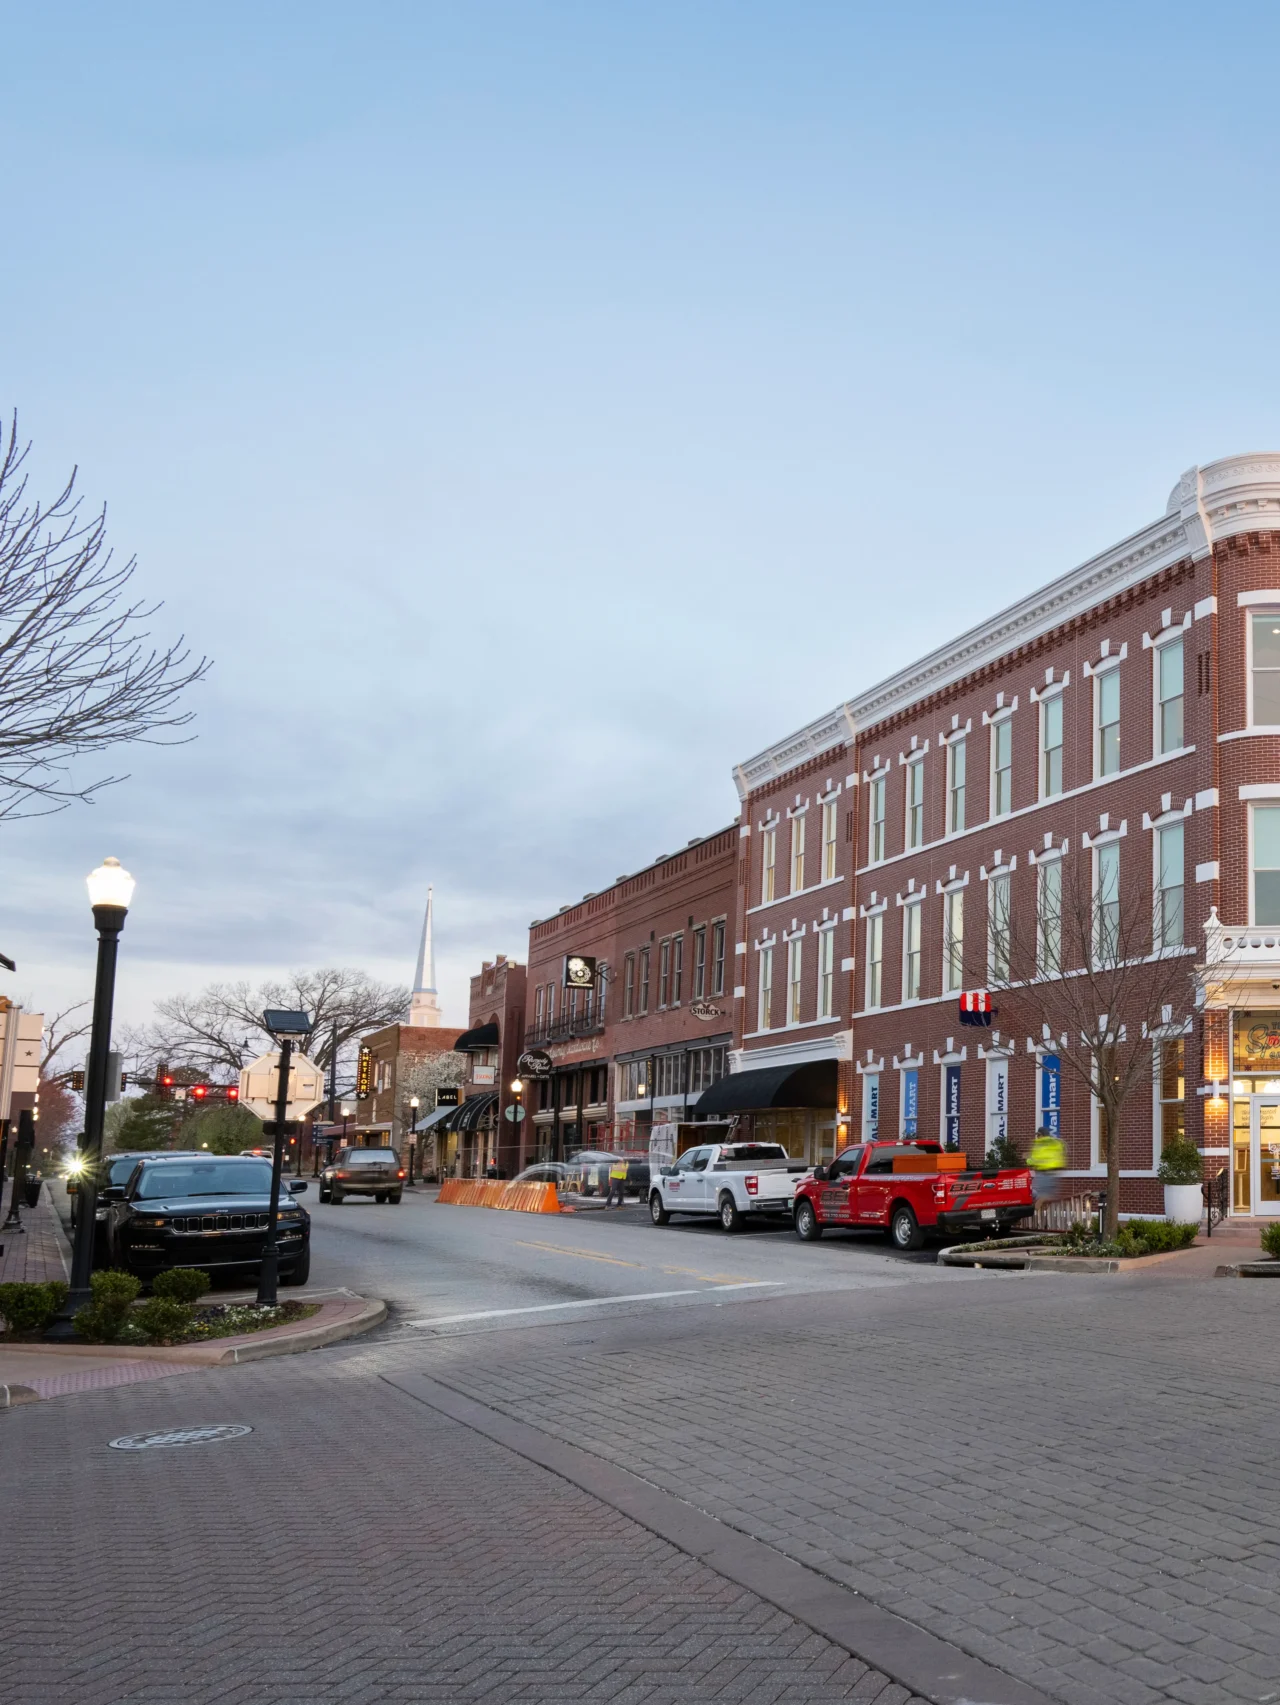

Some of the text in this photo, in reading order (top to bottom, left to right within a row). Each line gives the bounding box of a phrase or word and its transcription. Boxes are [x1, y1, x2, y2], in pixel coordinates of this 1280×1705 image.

[692, 1007, 719, 1015] STORCK
[361, 1056, 369, 1090] METEOR
[949, 1182, 982, 1192] BEI
